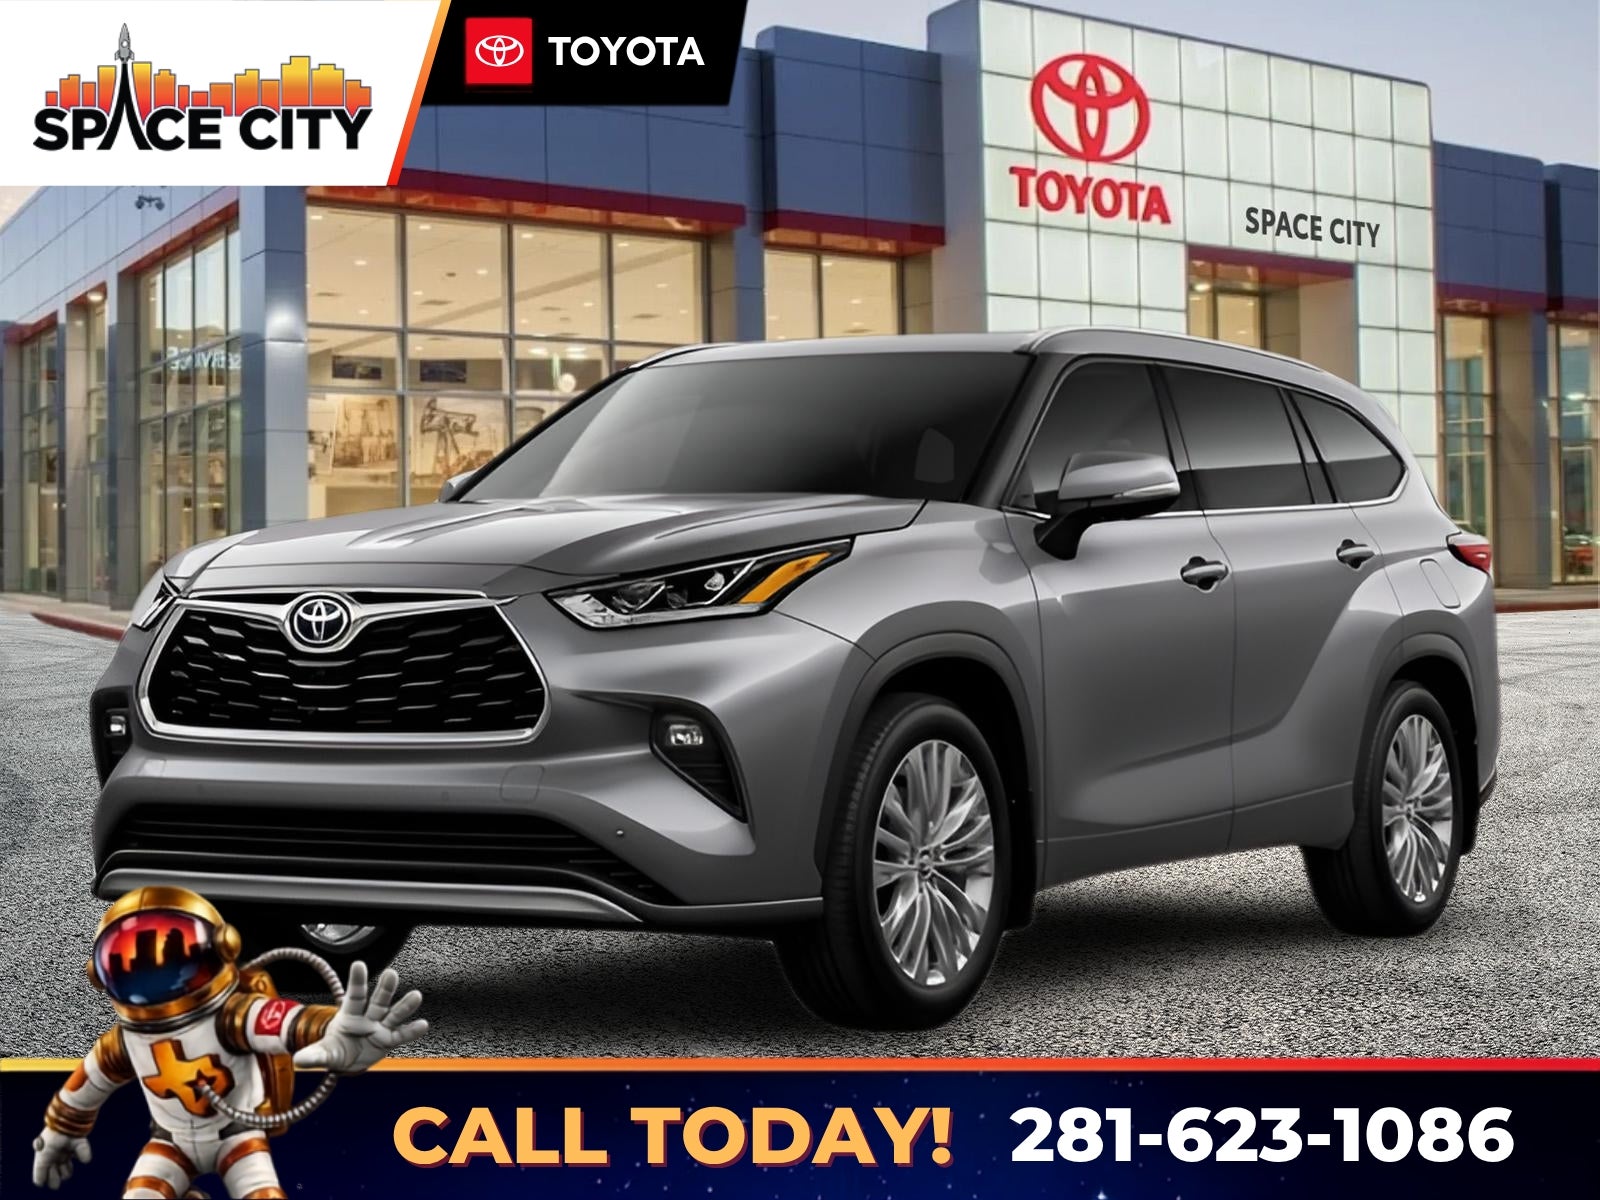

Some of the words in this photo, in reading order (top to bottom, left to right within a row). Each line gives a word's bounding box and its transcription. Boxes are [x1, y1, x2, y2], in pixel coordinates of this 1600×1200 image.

[1009, 166, 1171, 224] TOYOTA
[1244, 206, 1322, 242] SPACE
[1329, 216, 1381, 248] CITY
